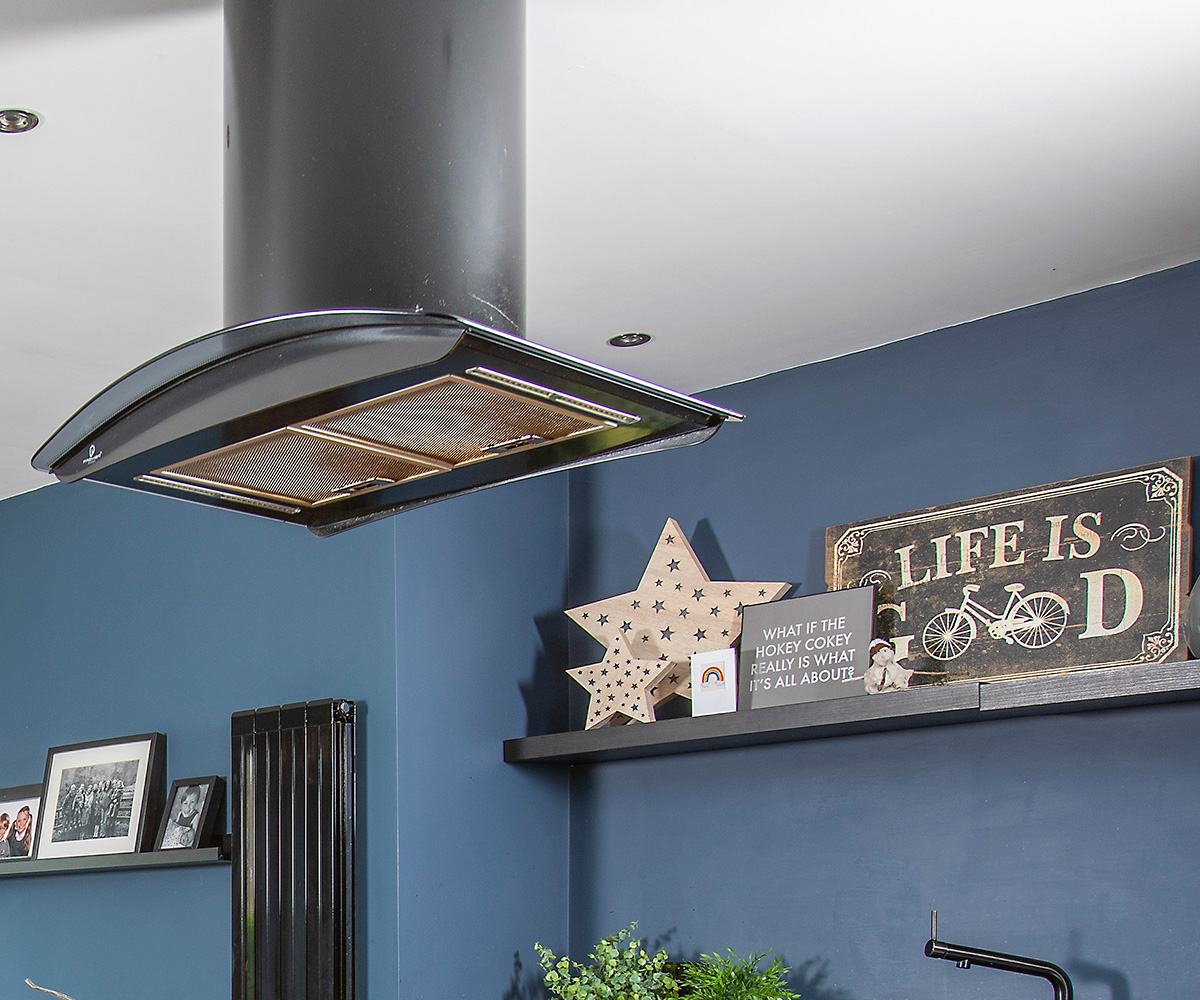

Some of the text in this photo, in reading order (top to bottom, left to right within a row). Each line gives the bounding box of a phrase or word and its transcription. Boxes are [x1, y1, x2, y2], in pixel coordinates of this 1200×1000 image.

[894, 512, 1102, 591] LIFE IS
[763, 617, 846, 640] WHAT IF THE
[755, 632, 852, 658] HOKEY COKEY
[751, 649, 856, 675] REALLY IS WHAT
[749, 666, 855, 692] IT'S ALL ABOUT?
